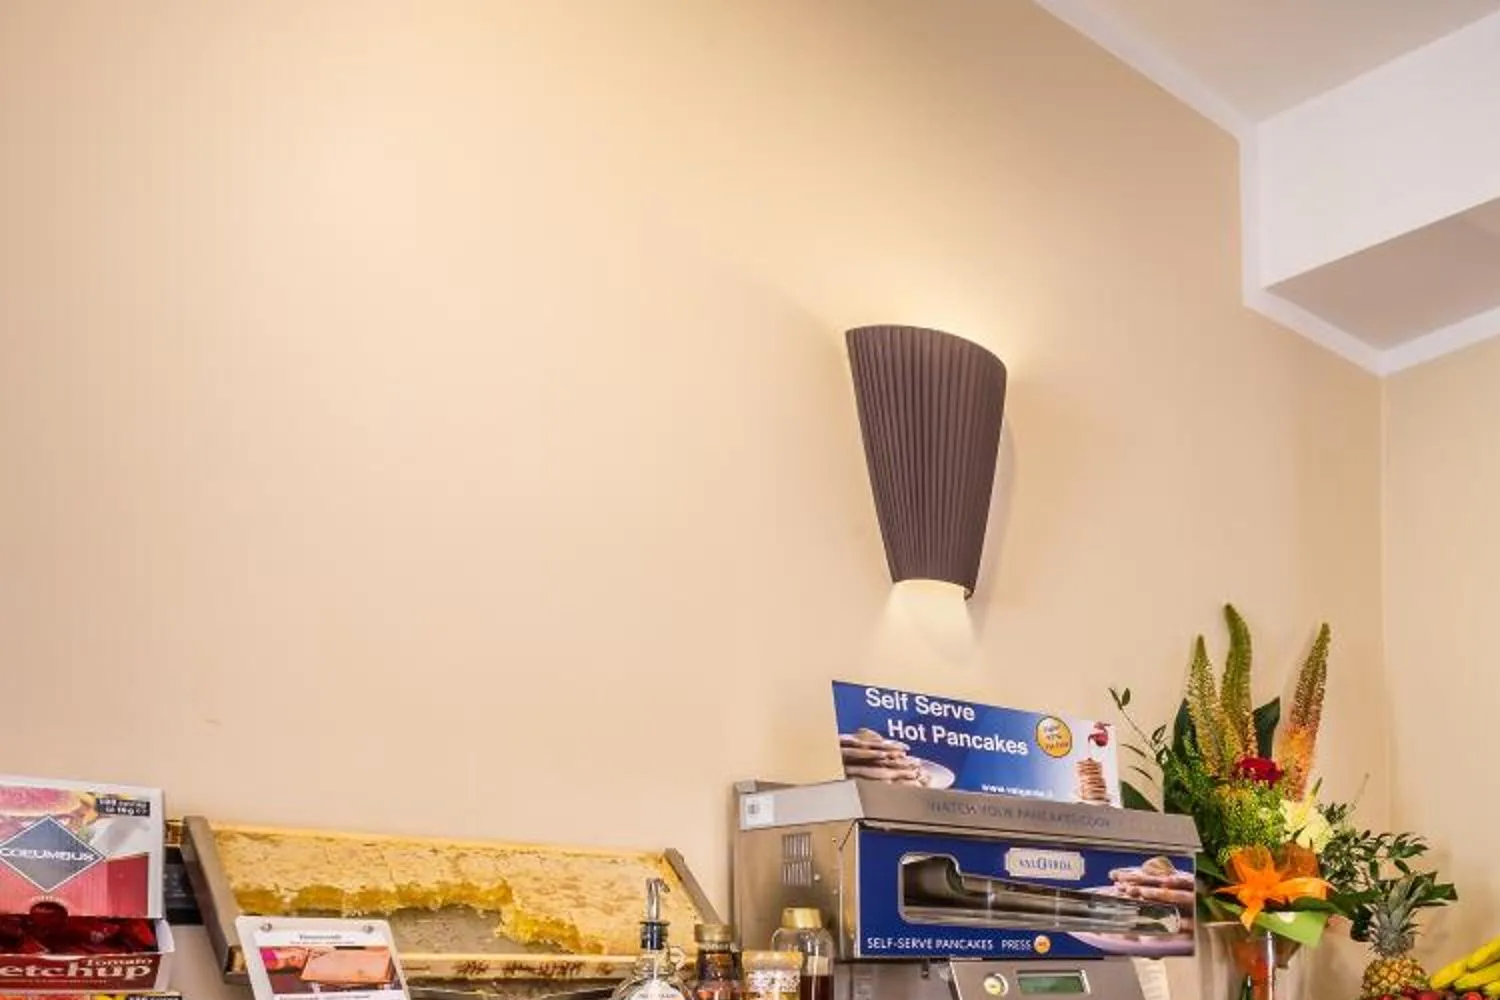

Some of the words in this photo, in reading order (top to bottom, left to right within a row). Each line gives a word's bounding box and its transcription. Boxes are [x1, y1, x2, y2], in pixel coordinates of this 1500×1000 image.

[865, 687, 908, 712] Self
[915, 695, 976, 722] Serve
[887, 719, 927, 743] Hot
[932, 725, 1029, 756] Pancakes
[867, 937, 933, 950] SELF-SERVE
[936, 938, 993, 950] PANCAKES
[1001, 938, 1031, 951] PRESS
[0, 962, 150, 980] etchup
